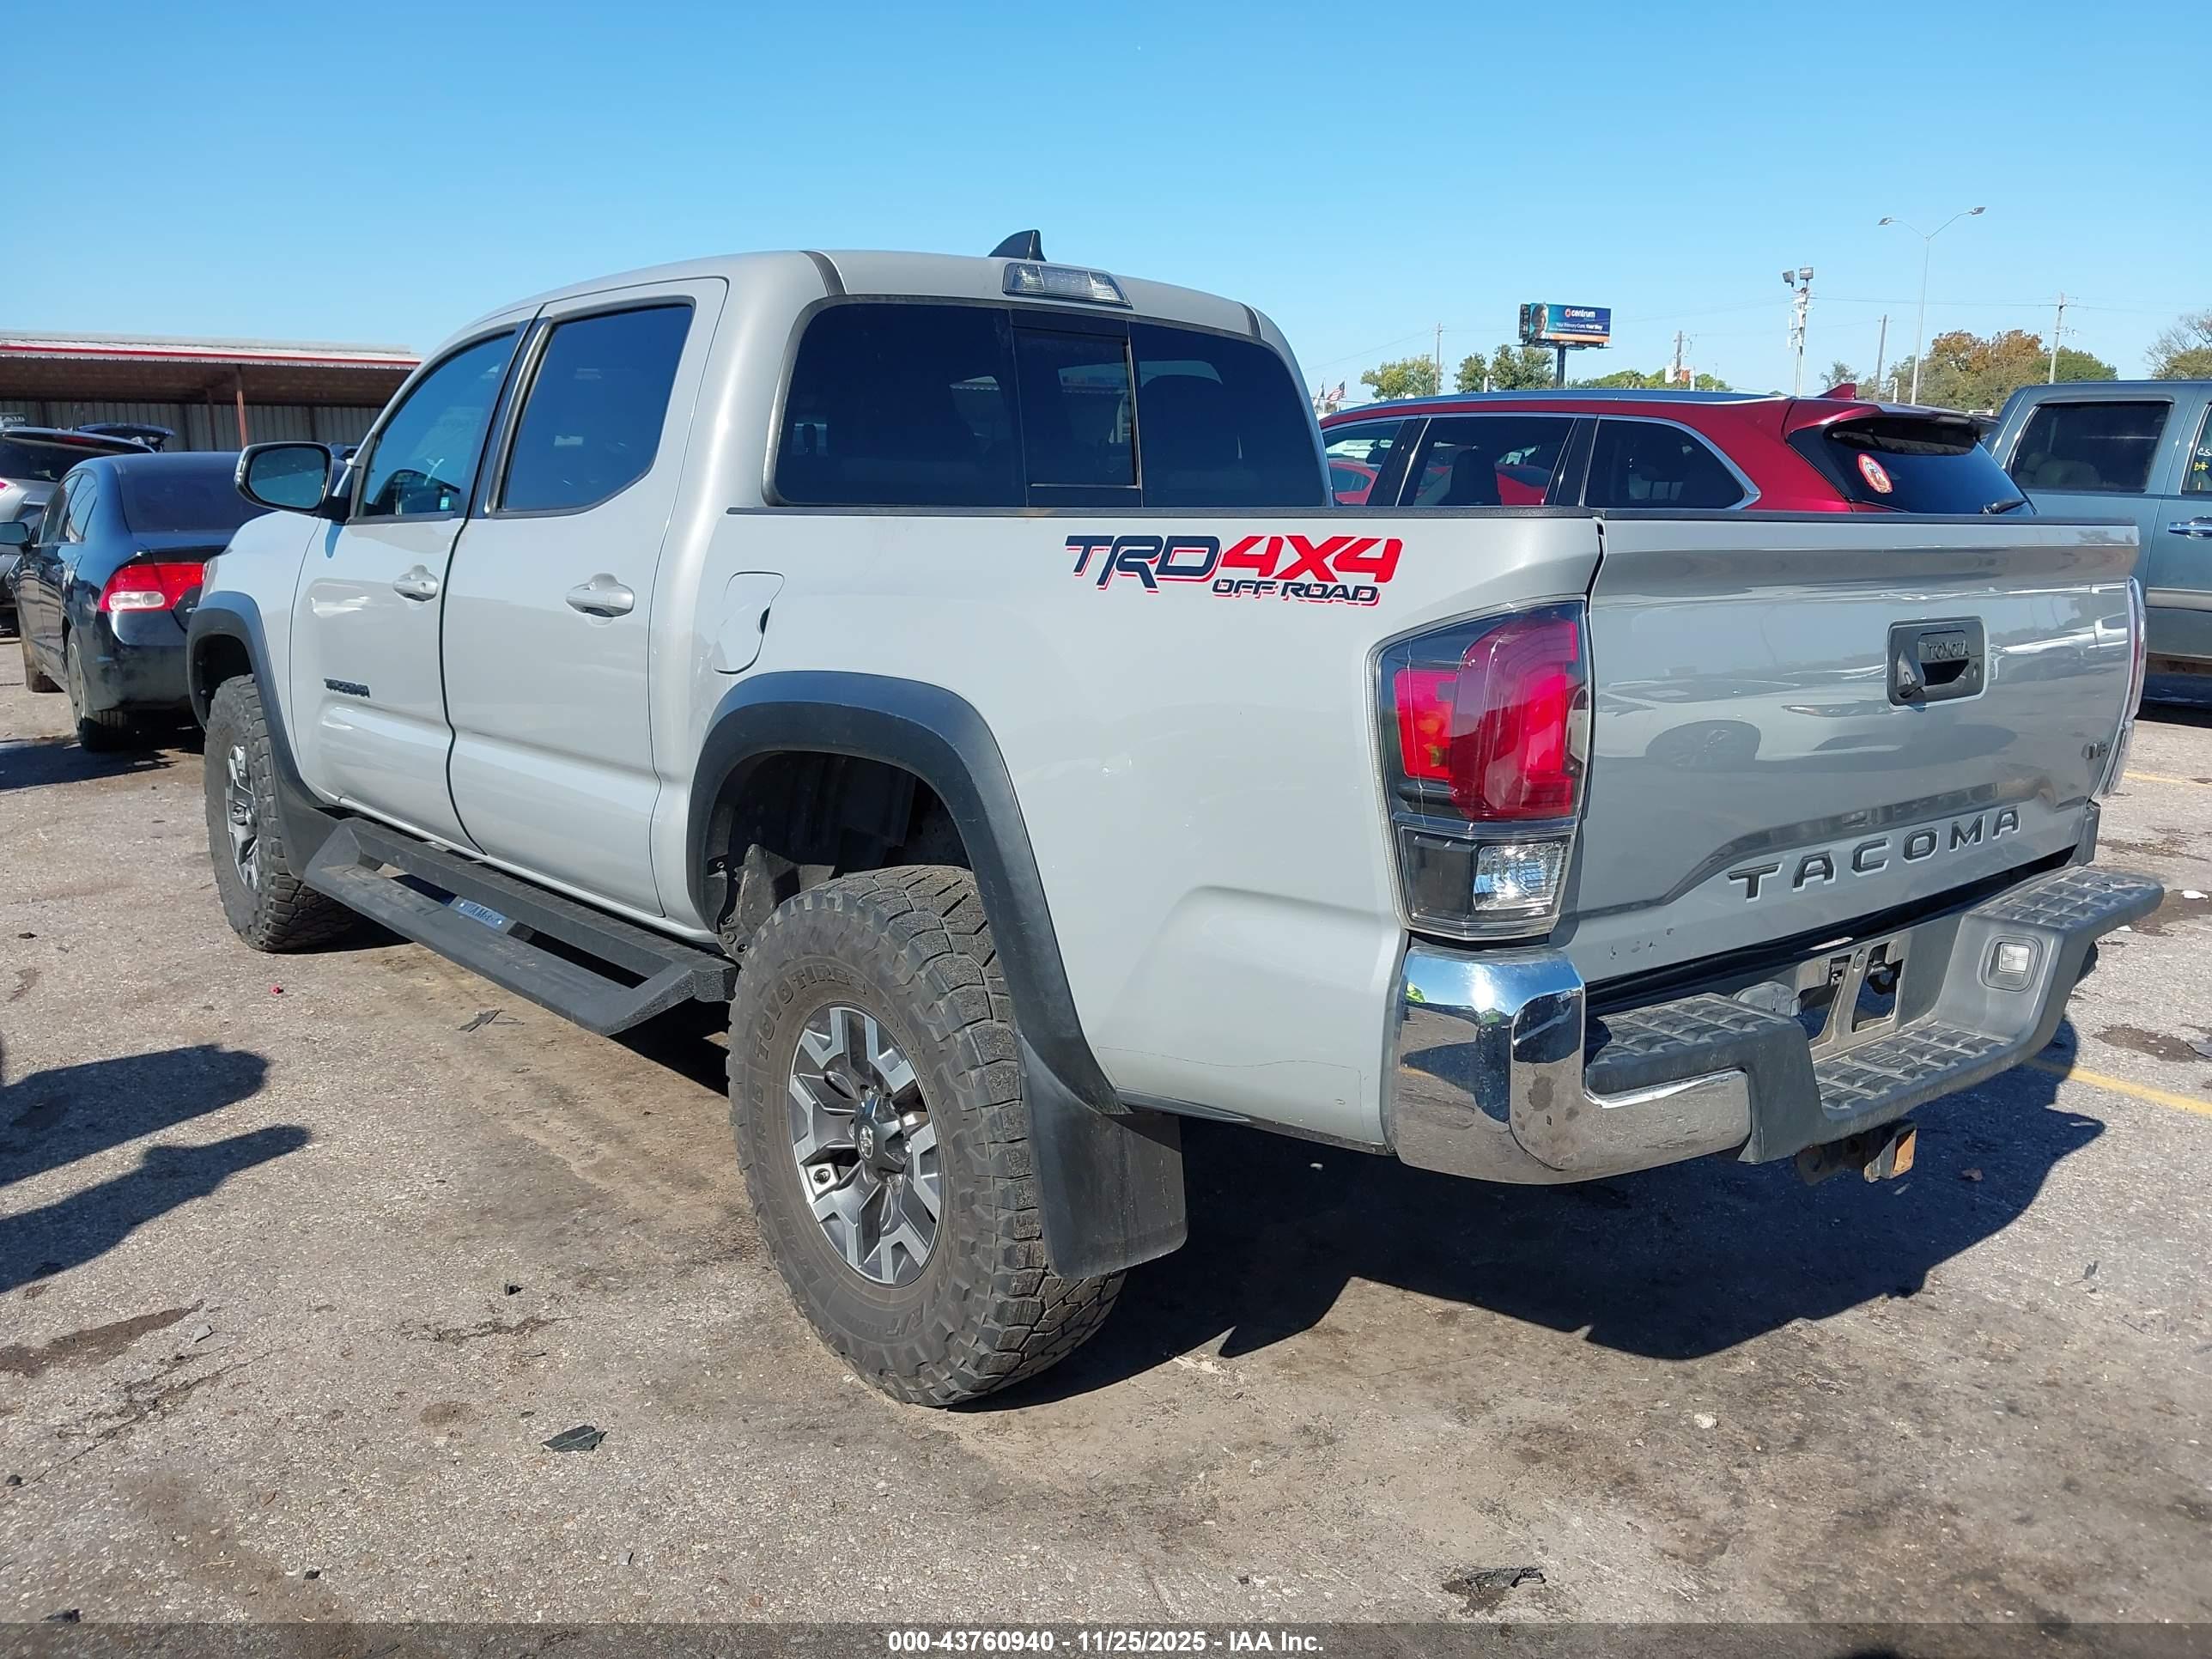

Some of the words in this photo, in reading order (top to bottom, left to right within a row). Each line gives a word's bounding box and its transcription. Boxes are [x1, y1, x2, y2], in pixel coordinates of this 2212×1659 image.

[1065, 535, 1223, 593] TRD
[1212, 578, 1278, 599] OFF
[1280, 581, 1381, 607] ROAD
[1929, 640, 1971, 659] TOYOTA
[1727, 808, 2021, 903] TACOMA
